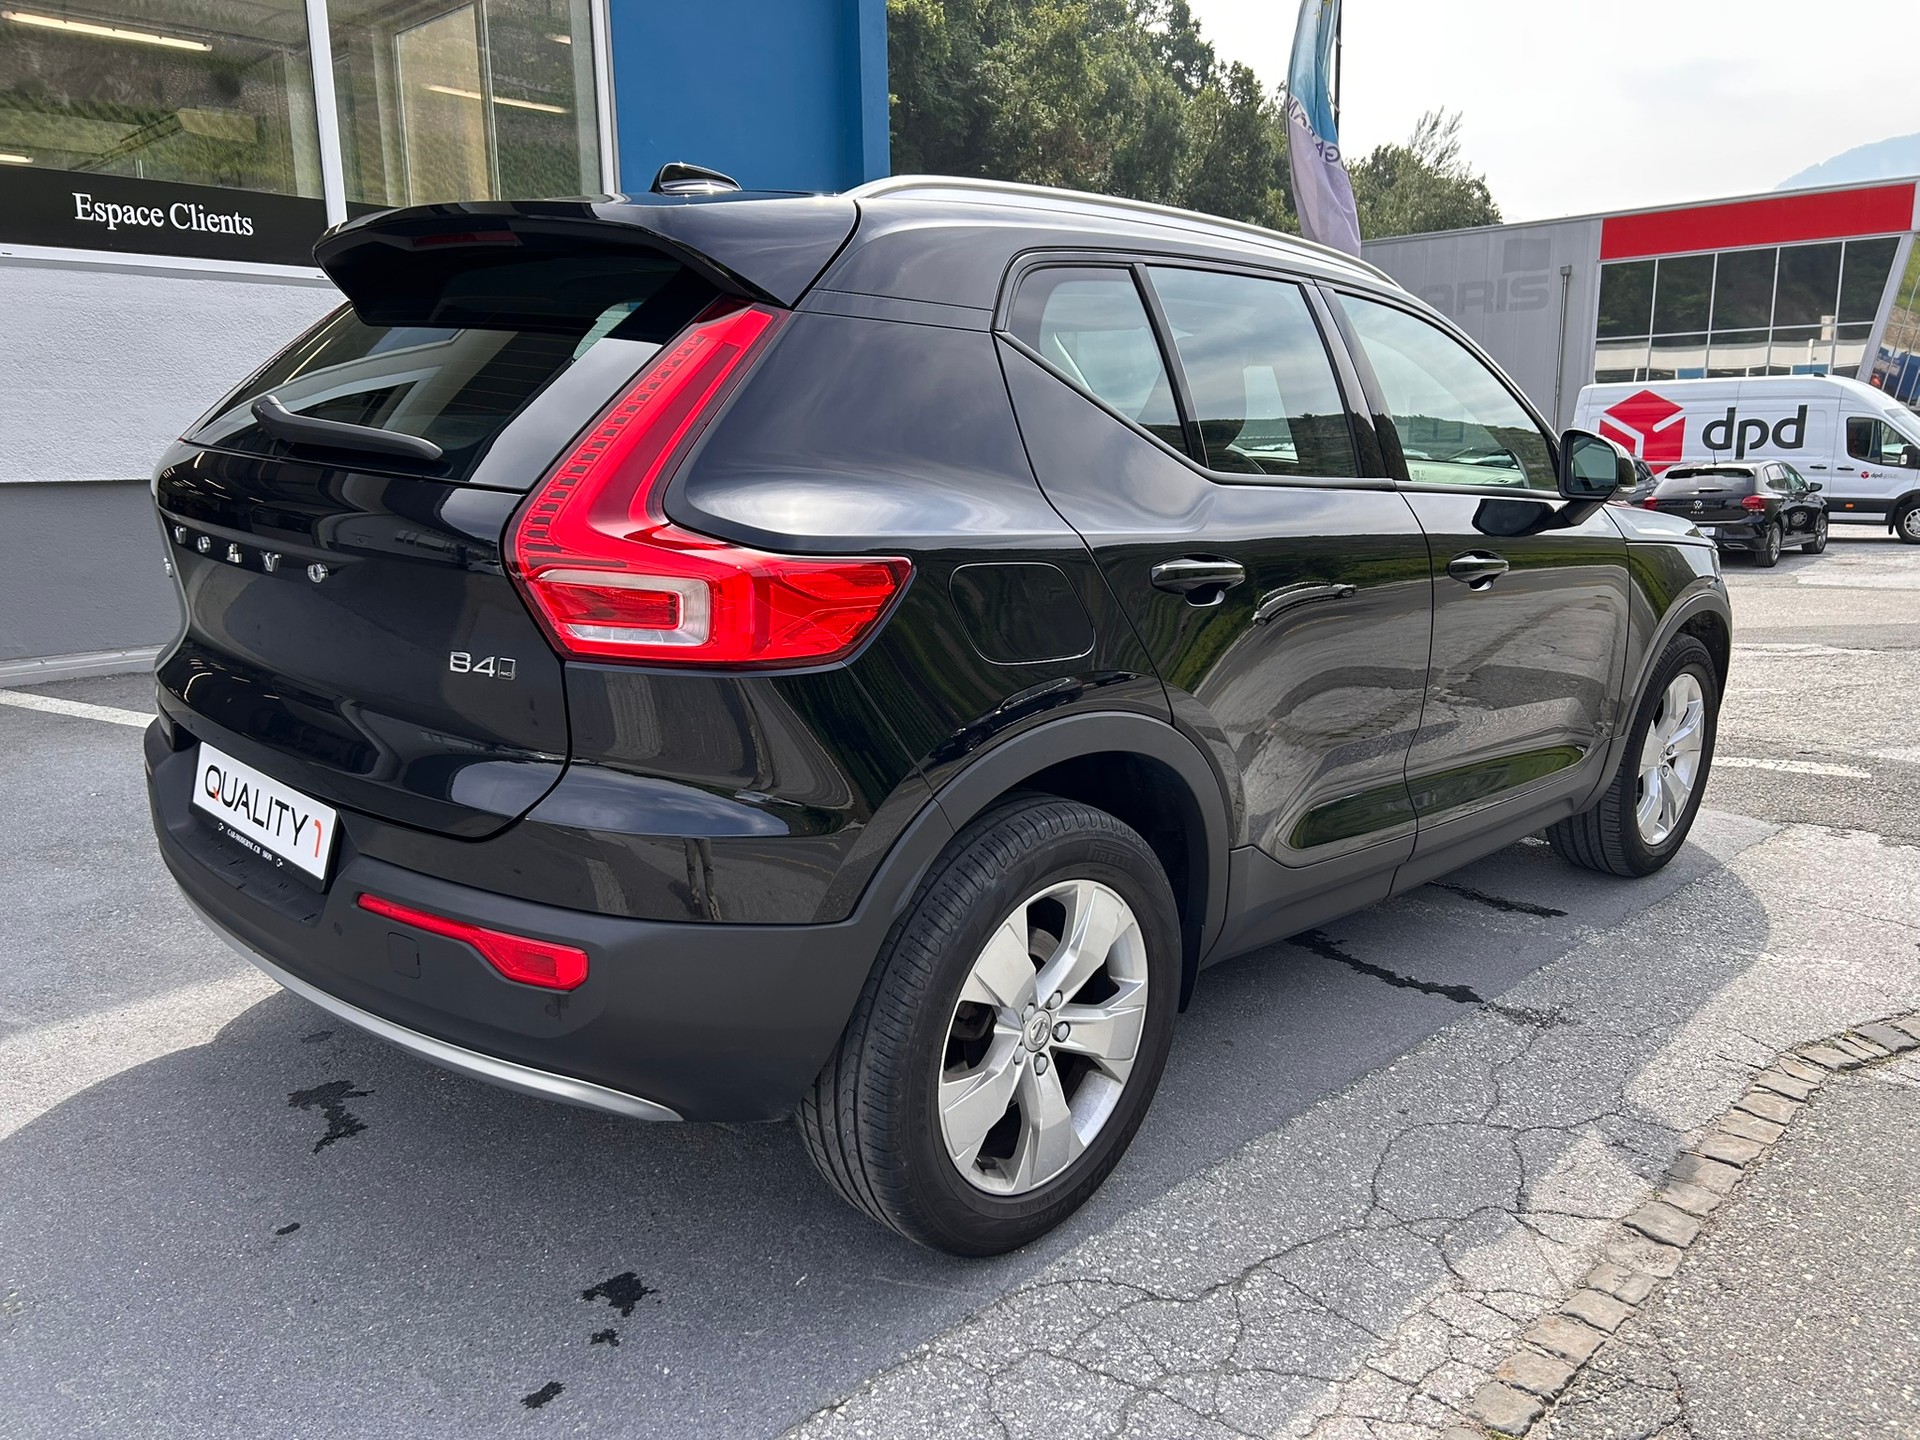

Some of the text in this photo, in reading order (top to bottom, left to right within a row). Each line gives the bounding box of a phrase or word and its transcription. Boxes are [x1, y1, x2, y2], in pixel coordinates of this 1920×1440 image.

[72, 192, 254, 236] Espace Clients
[1701, 404, 1808, 460] dpd
[449, 651, 496, 677] B4
